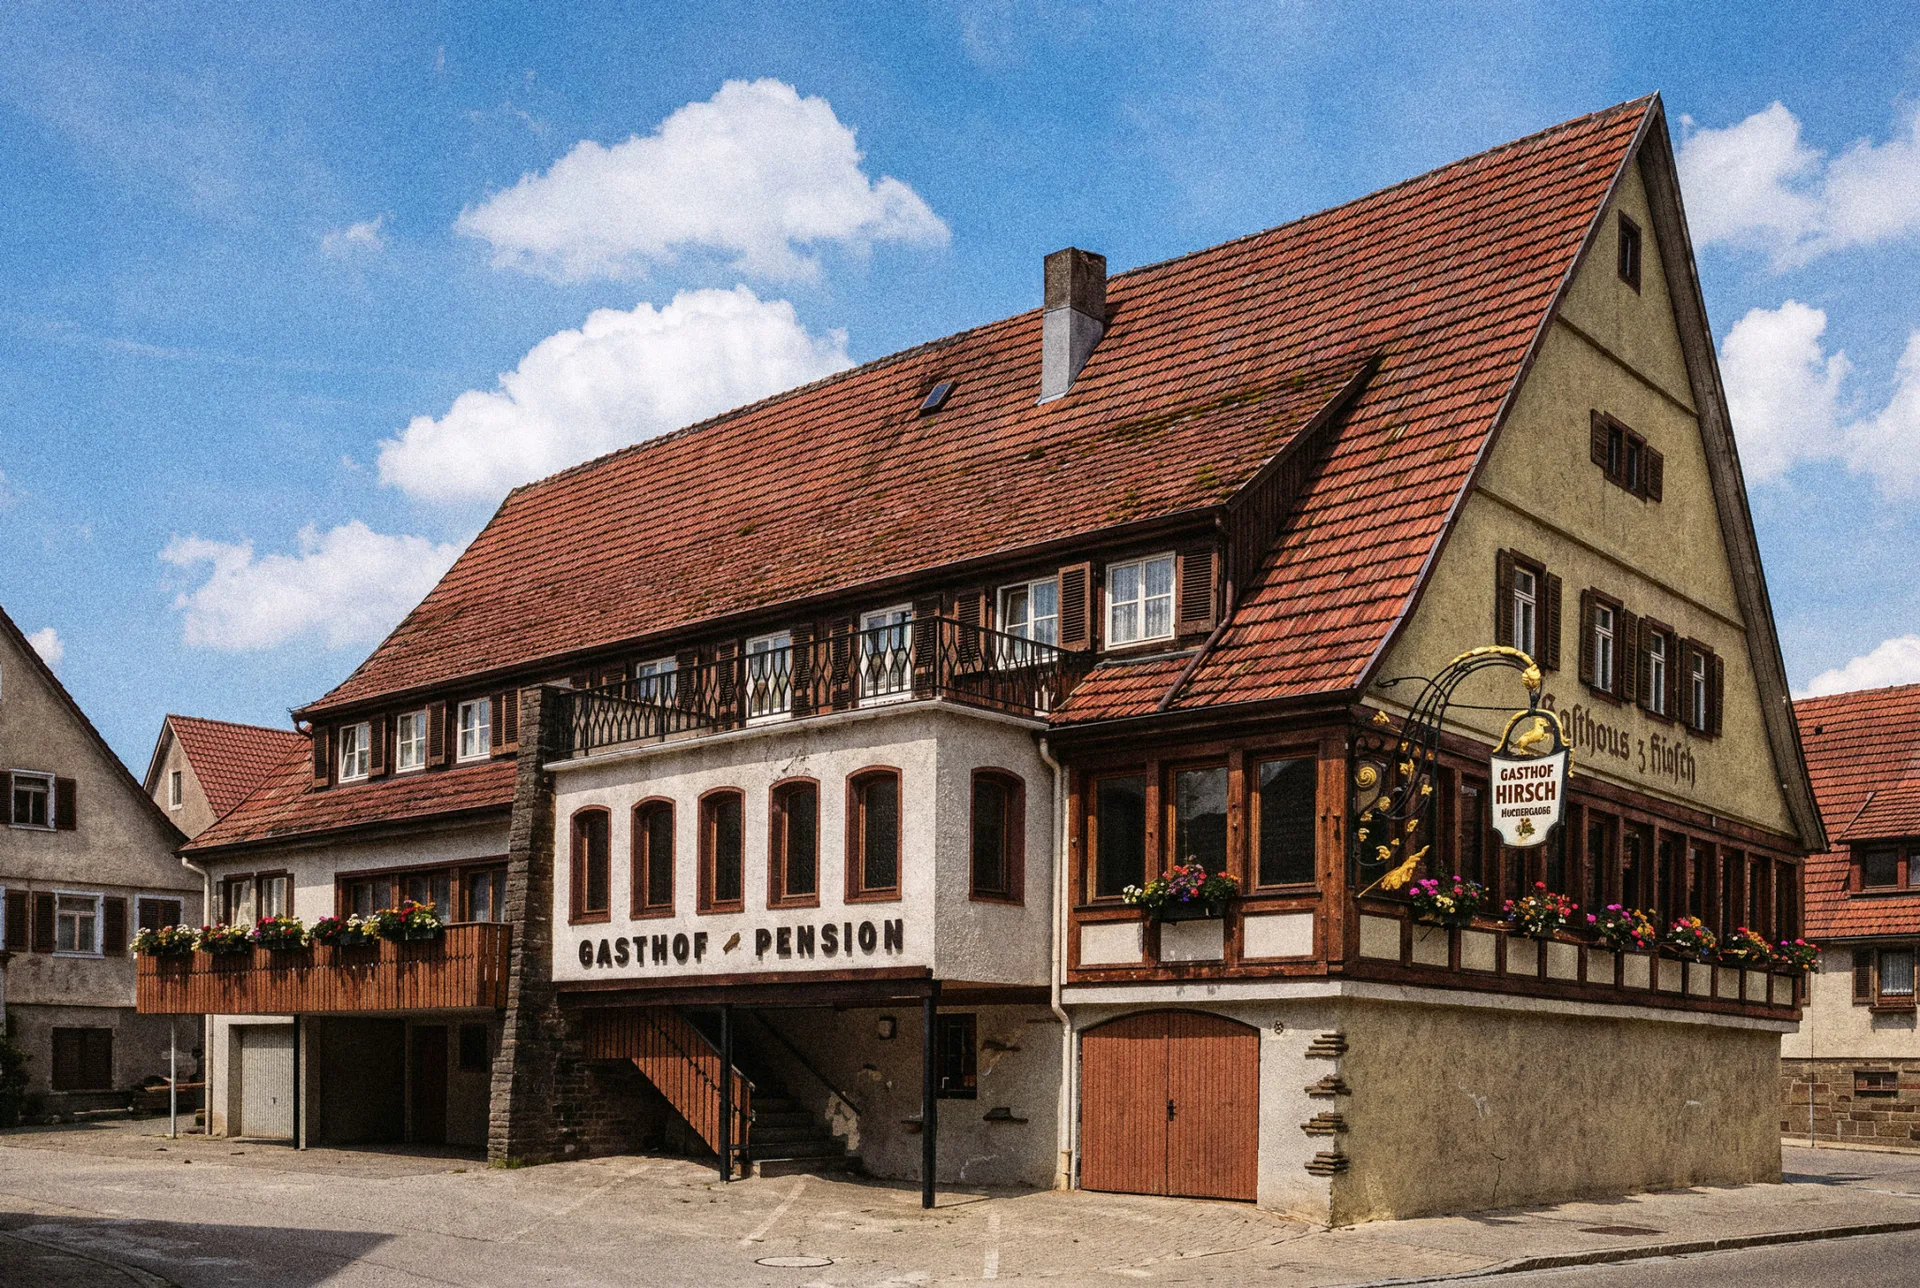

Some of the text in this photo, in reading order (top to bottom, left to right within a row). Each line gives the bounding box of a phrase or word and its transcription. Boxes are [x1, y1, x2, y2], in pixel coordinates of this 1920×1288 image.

[1500, 764, 1554, 781] GASTHOF
[1495, 781, 1556, 804] HIRSCH
[579, 919, 903, 967] GASTHOF PENSION
